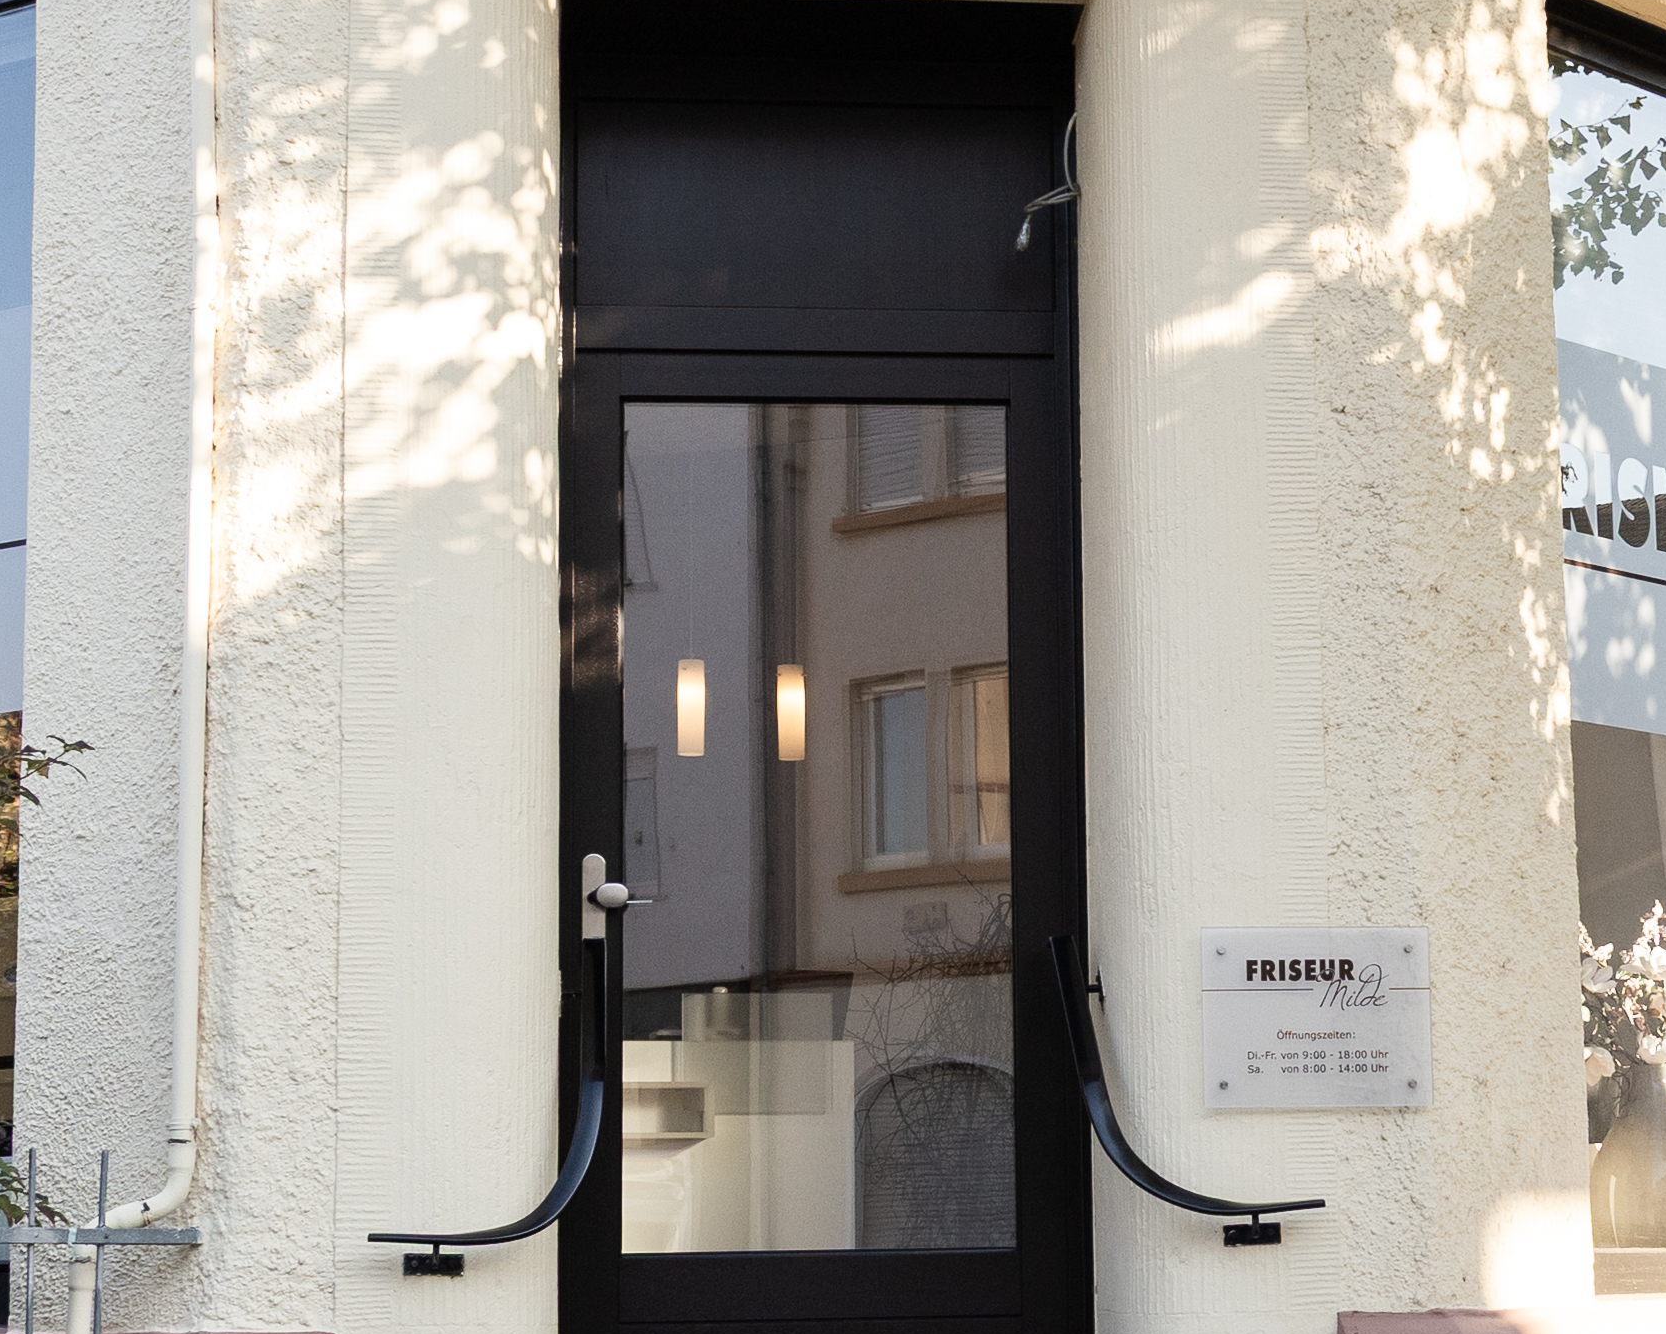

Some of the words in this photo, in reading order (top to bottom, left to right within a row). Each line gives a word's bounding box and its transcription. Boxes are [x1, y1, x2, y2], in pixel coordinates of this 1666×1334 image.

[1246, 959, 1355, 981] FRISEUR
[1315, 963, 1389, 1011] Milde
[1276, 1029, 1356, 1042] Öffnungszeiten:
[1247, 1050, 1278, 1061] Di.-Fr.
[1280, 1052, 1299, 1060] von
[1302, 1050, 1326, 1060] 9:00
[1337, 1049, 1368, 1060] 18:00
[1370, 1049, 1389, 1059] Uhr
[1247, 1064, 1264, 1074] Sa.
[1280, 1066, 1299, 1074] von
[1302, 1064, 1327, 1074] 8:00
[1338, 1063, 1368, 1074] 14:00
[1370, 1063, 1389, 1073] Uhr
